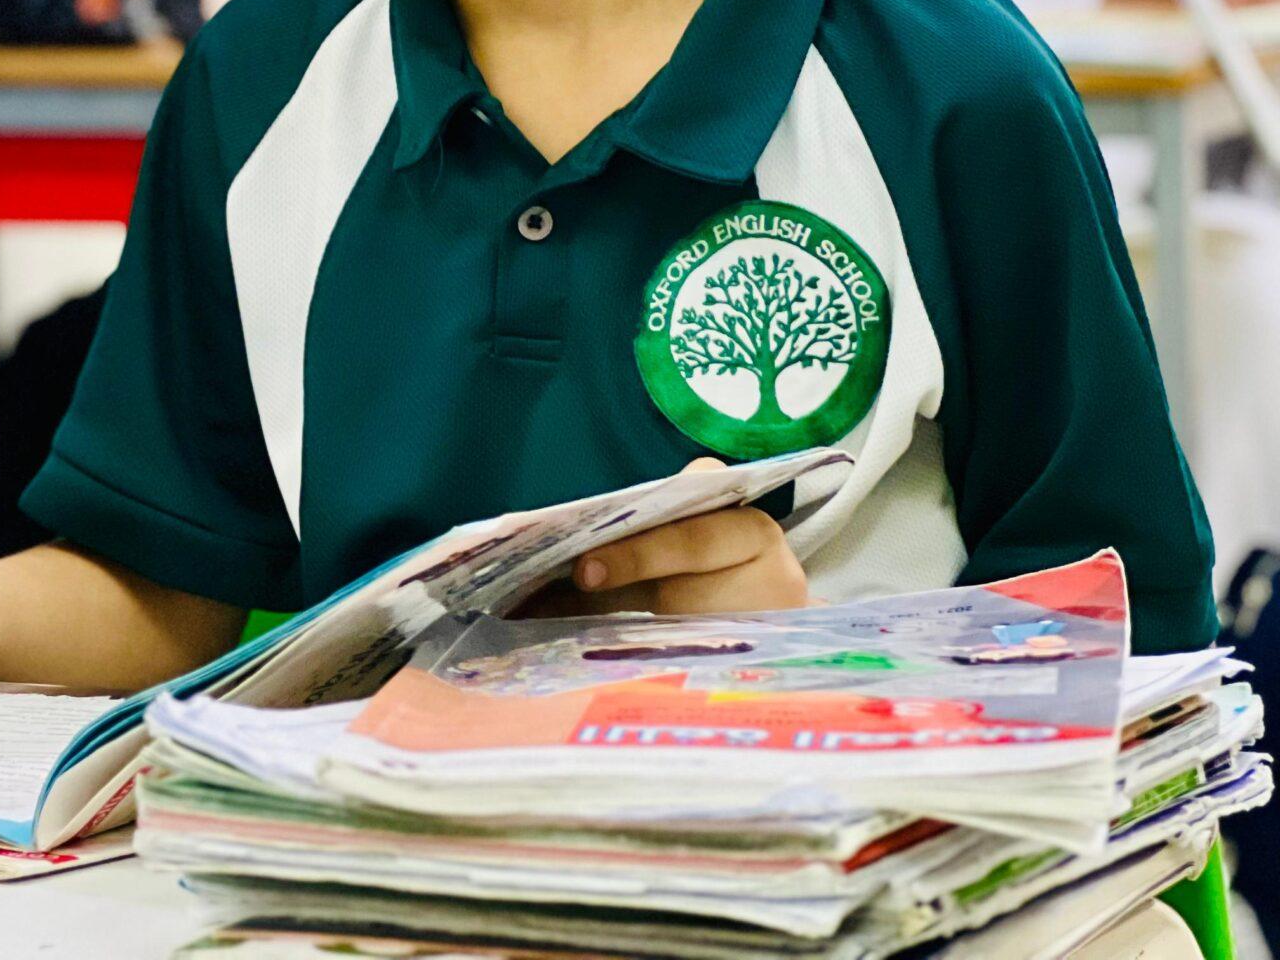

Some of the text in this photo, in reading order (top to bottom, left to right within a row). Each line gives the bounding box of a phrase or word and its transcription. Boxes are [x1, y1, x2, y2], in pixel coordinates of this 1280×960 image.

[648, 214, 880, 332] OXFORD ENGLISH SCHOOL
